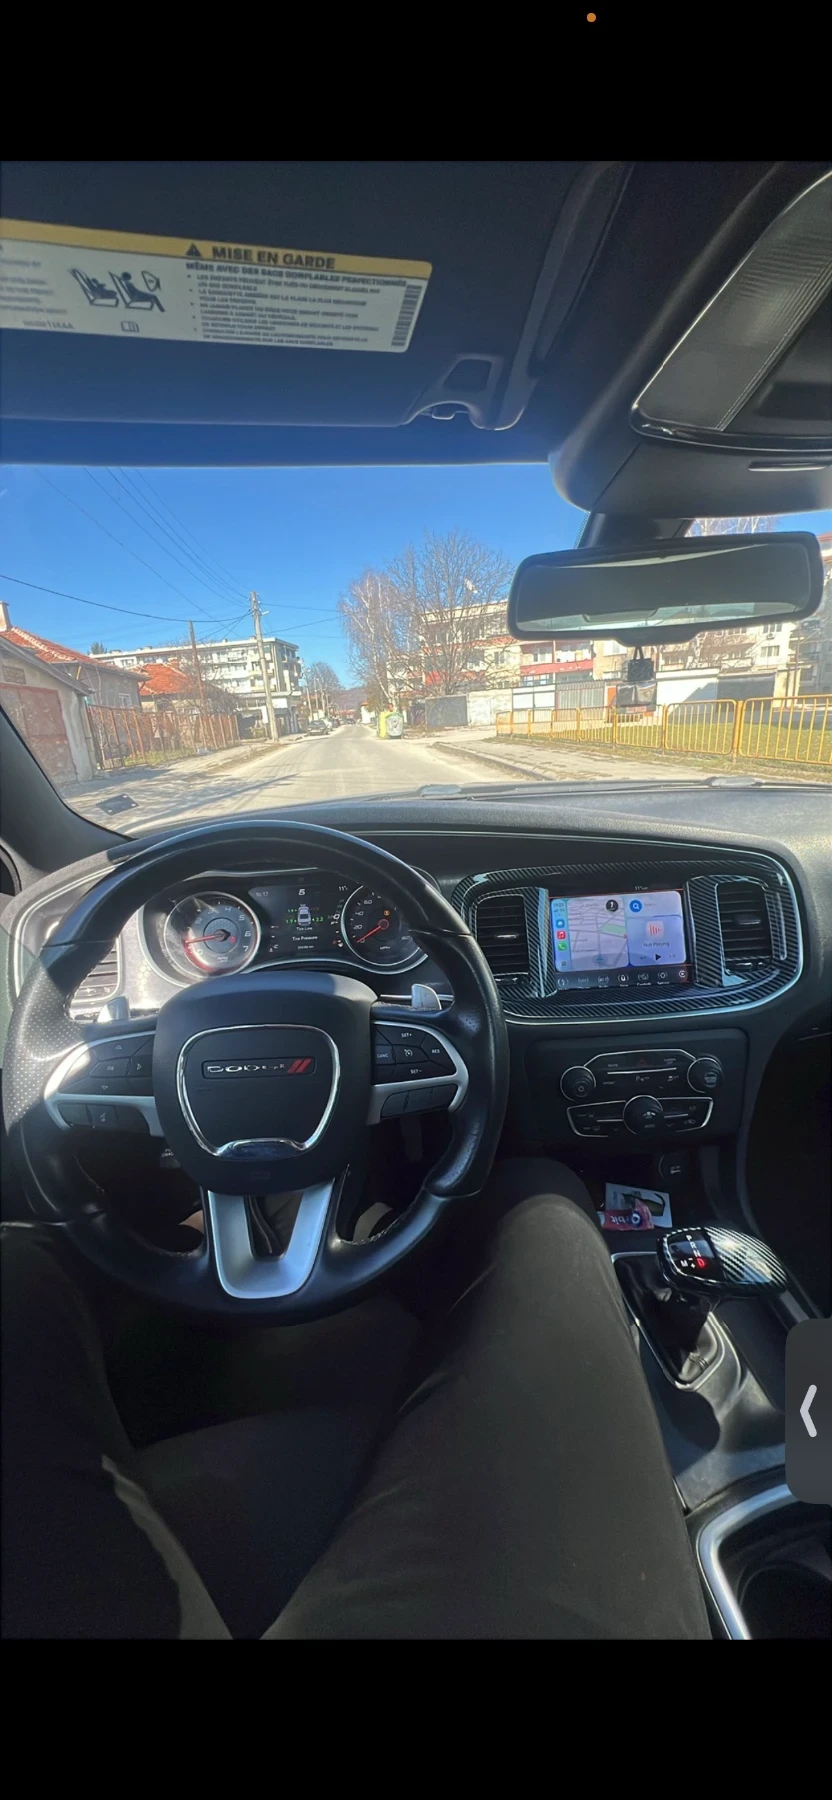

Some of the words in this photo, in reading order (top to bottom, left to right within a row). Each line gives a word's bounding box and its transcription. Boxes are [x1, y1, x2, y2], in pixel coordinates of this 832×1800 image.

[211, 246, 252, 260] MISE
[257, 251, 278, 264] EN
[283, 253, 335, 269] GARDE
[186, 261, 214, 272] MÊME
[216, 265, 240, 274] AVEC
[242, 266, 259, 275] DES
[261, 269, 284, 278] SACS
[696, 1257, 705, 1268] D
